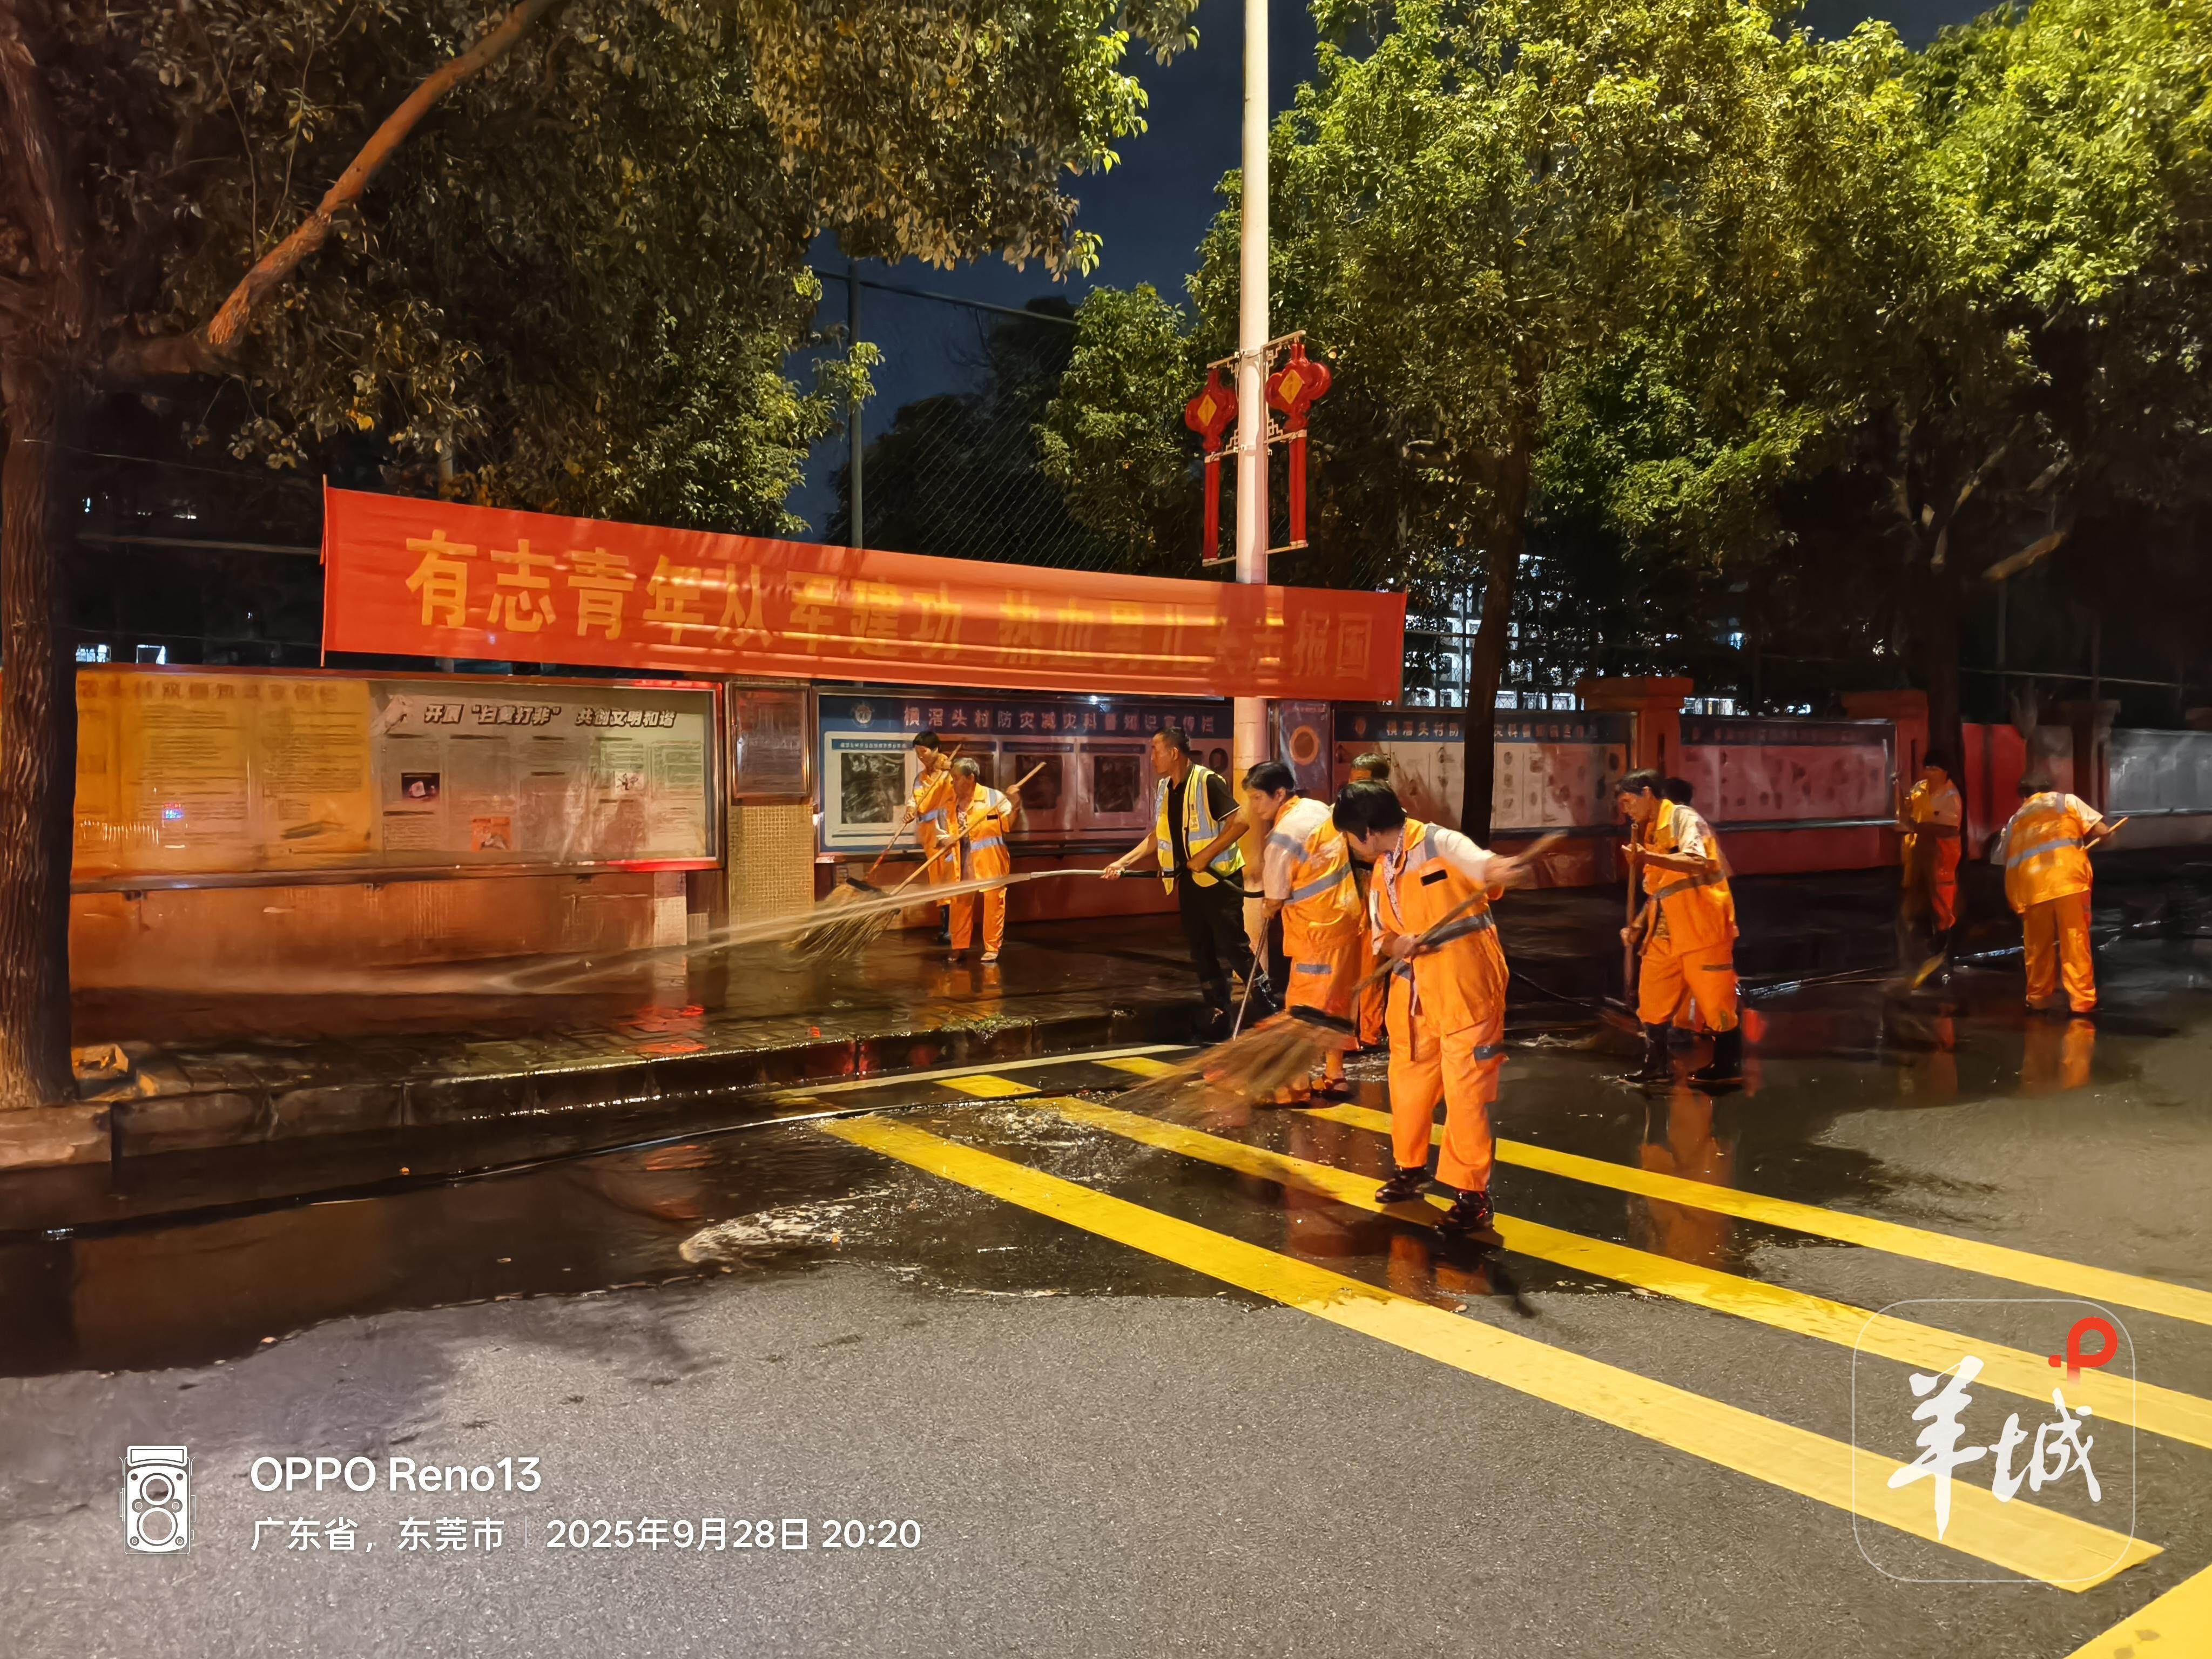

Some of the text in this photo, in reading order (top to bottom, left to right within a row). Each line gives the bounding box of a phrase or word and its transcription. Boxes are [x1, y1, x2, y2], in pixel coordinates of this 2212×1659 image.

[575, 706, 677, 728] 共创文明和谐
